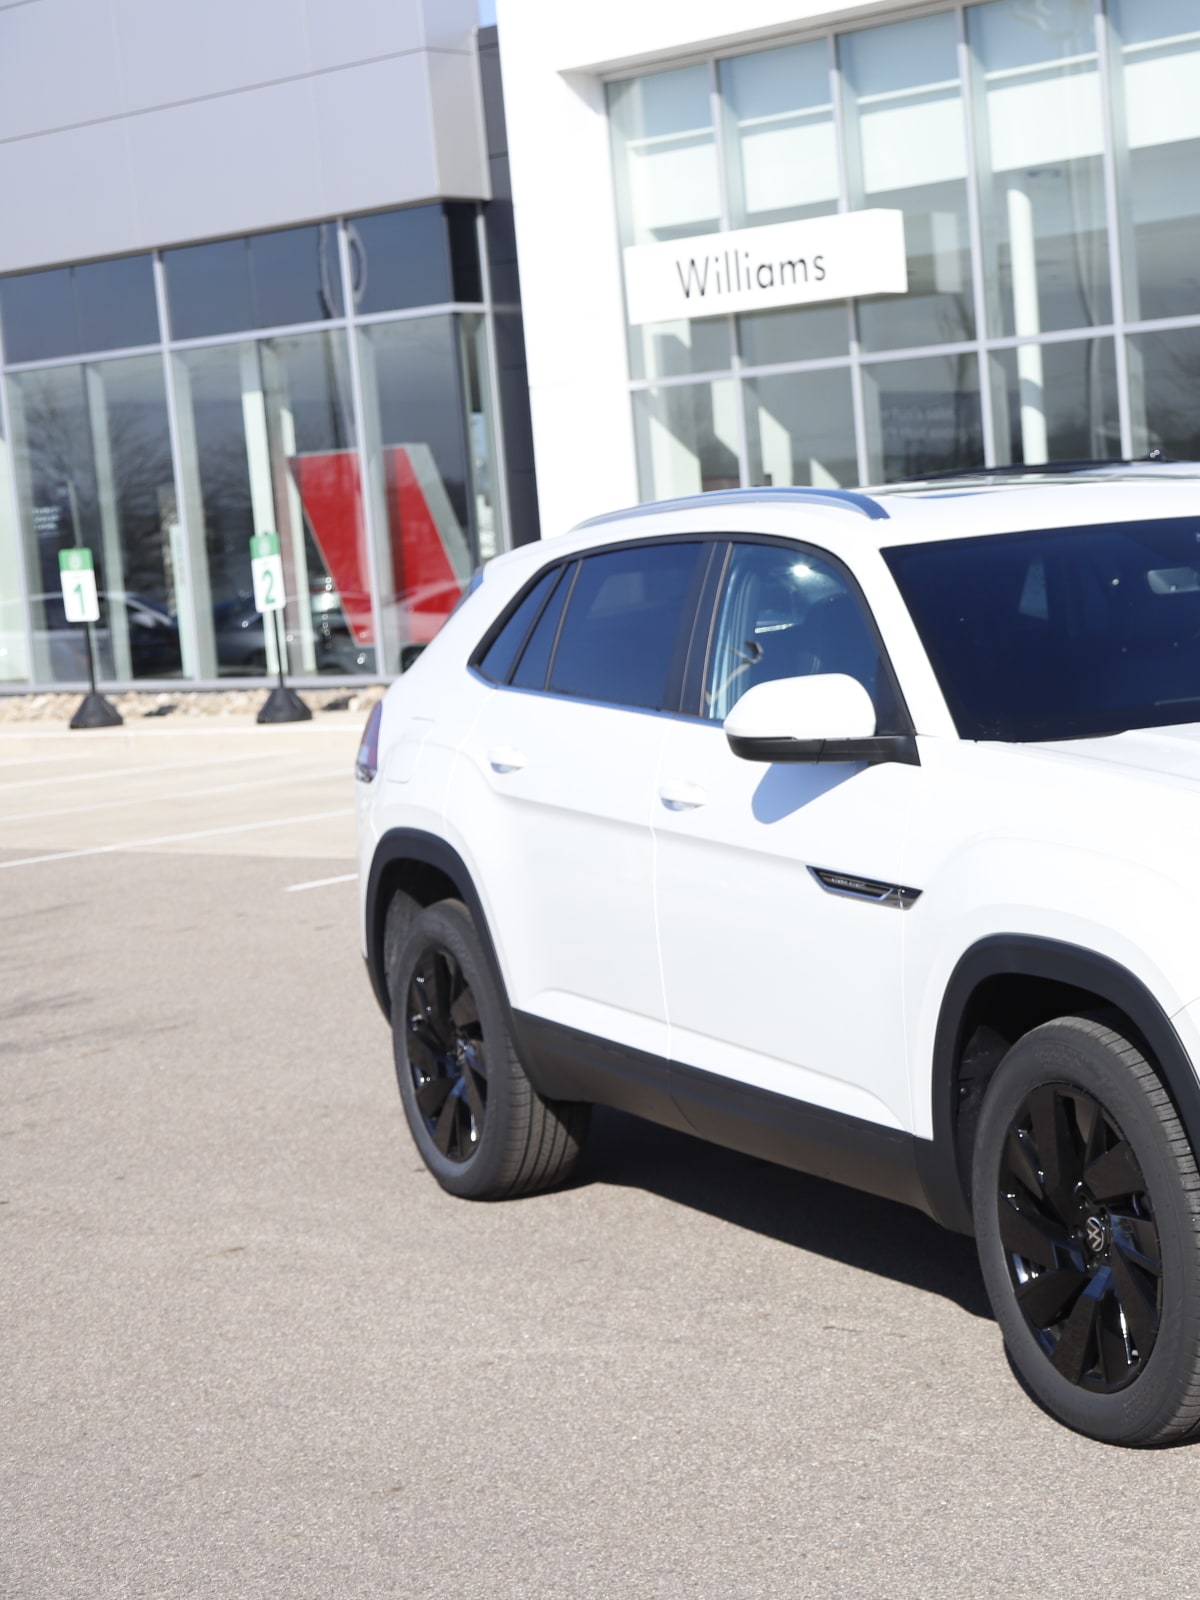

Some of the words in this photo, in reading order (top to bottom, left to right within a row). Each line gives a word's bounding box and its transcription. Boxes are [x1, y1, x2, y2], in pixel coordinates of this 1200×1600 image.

[676, 249, 826, 299] Williams
[73, 583, 86, 617] 1
[262, 569, 276, 605] 2
